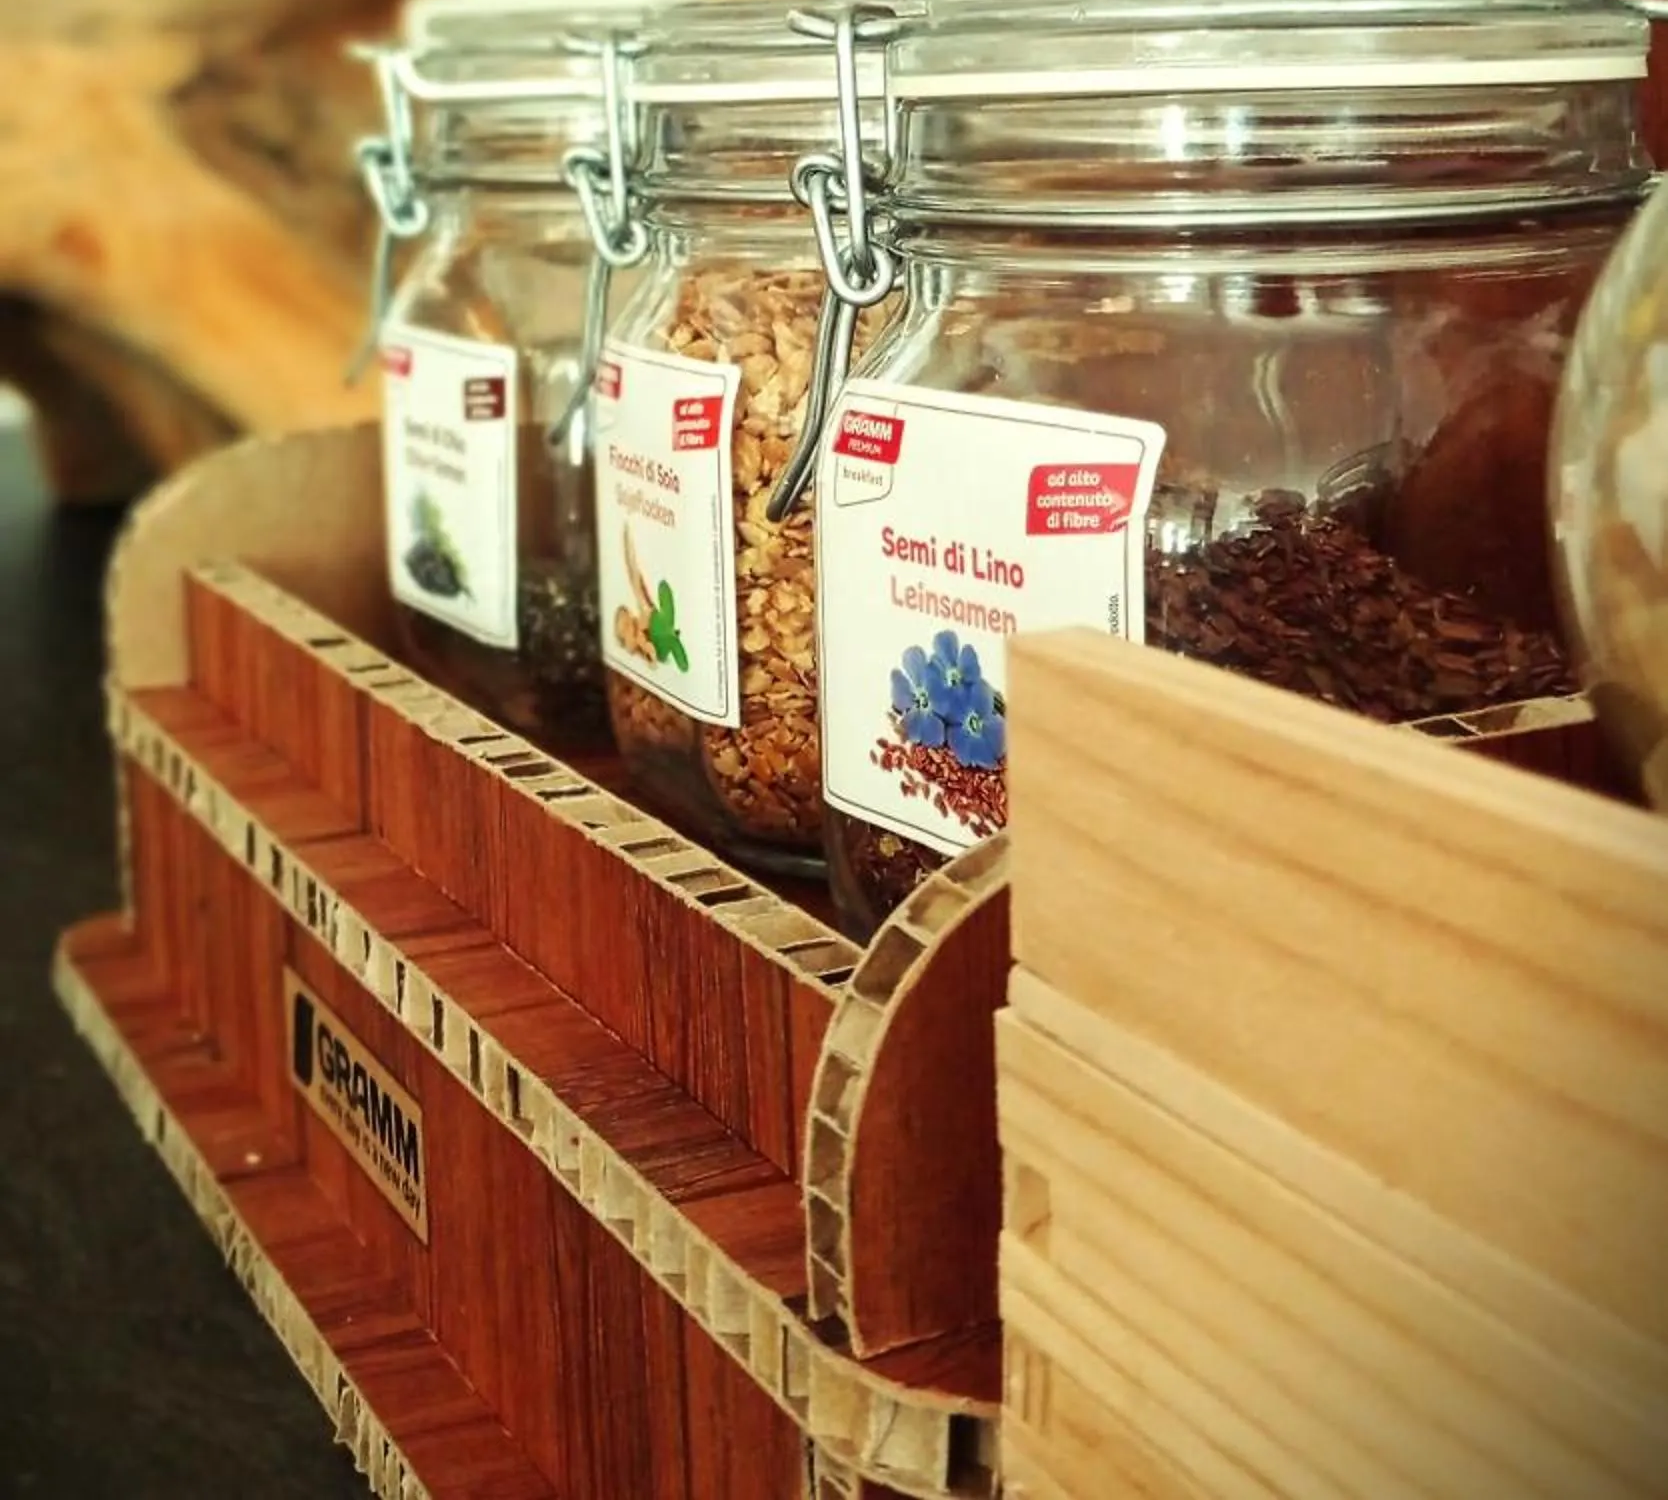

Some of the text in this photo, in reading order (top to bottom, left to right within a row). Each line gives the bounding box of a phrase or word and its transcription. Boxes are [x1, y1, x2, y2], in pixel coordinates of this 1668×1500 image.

[843, 414, 894, 442] GRAMM
[609, 444, 681, 495] Fiocchi di Soia
[843, 465, 883, 487] breakfast
[1047, 470, 1100, 487] ad alto
[1036, 491, 1113, 509] contenuto
[1046, 510, 1100, 529] di fibre
[881, 525, 1025, 589] Semi di Lino
[890, 574, 1018, 635] Leinsamen
[1107, 593, 1119, 635] odotto.
[317, 1019, 420, 1186] GRAMM
